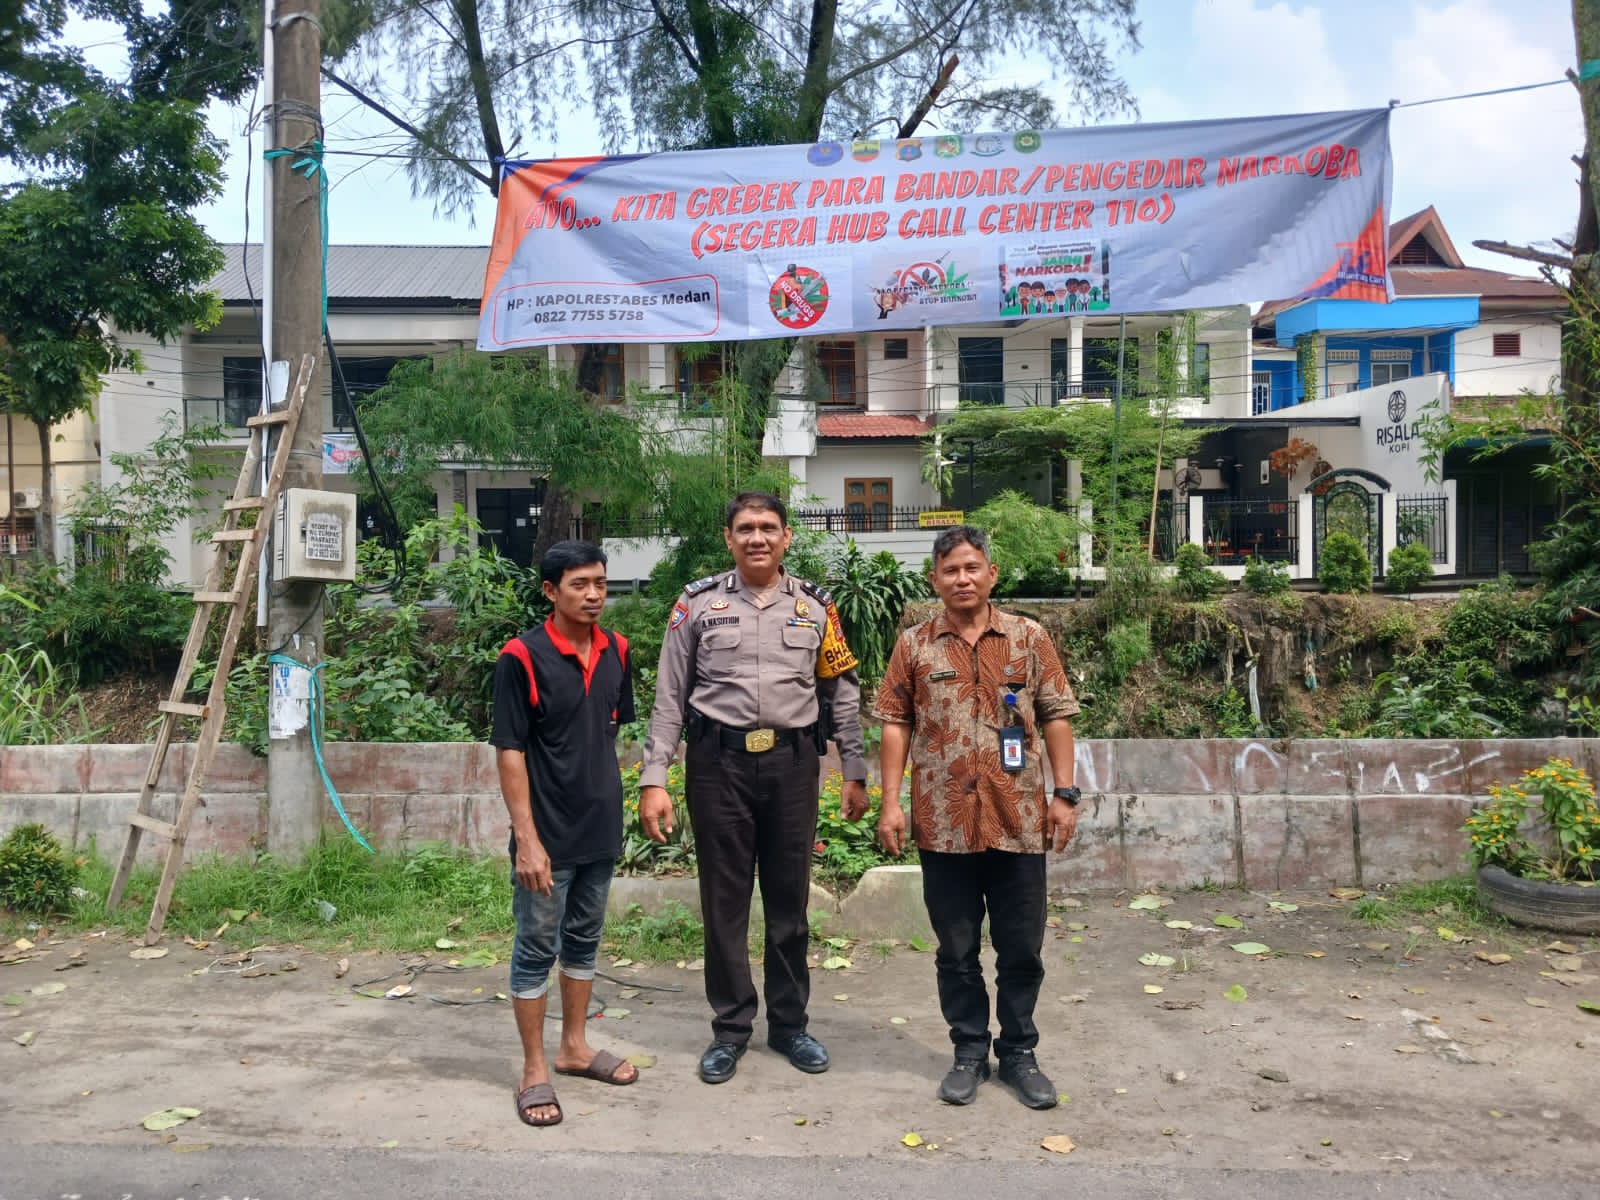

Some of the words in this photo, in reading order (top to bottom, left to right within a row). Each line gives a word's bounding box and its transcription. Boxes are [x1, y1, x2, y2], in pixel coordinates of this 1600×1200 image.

[525, 197, 600, 230] AYO...
[612, 191, 676, 222] KITA
[686, 181, 801, 219] GREBEK
[807, 176, 885, 208] PARA
[1217, 144, 1361, 187] NARKOBA
[691, 216, 817, 260] (SEGERA
[827, 211, 889, 244] HUB
[898, 206, 966, 239] CALL
[978, 200, 1094, 236] CENTER
[1106, 192, 1175, 226] 110)
[507, 299, 524, 311] HP
[535, 294, 658, 306] KAPOLRESTABES
[662, 290, 710, 305] Medan
[790, 291, 815, 317] DRUGS
[534, 311, 566, 323] 0822
[571, 310, 604, 321] 7755
[609, 310, 644, 321] 5758
[1377, 422, 1420, 446] RISALA
[1389, 442, 1411, 454] KOPI
